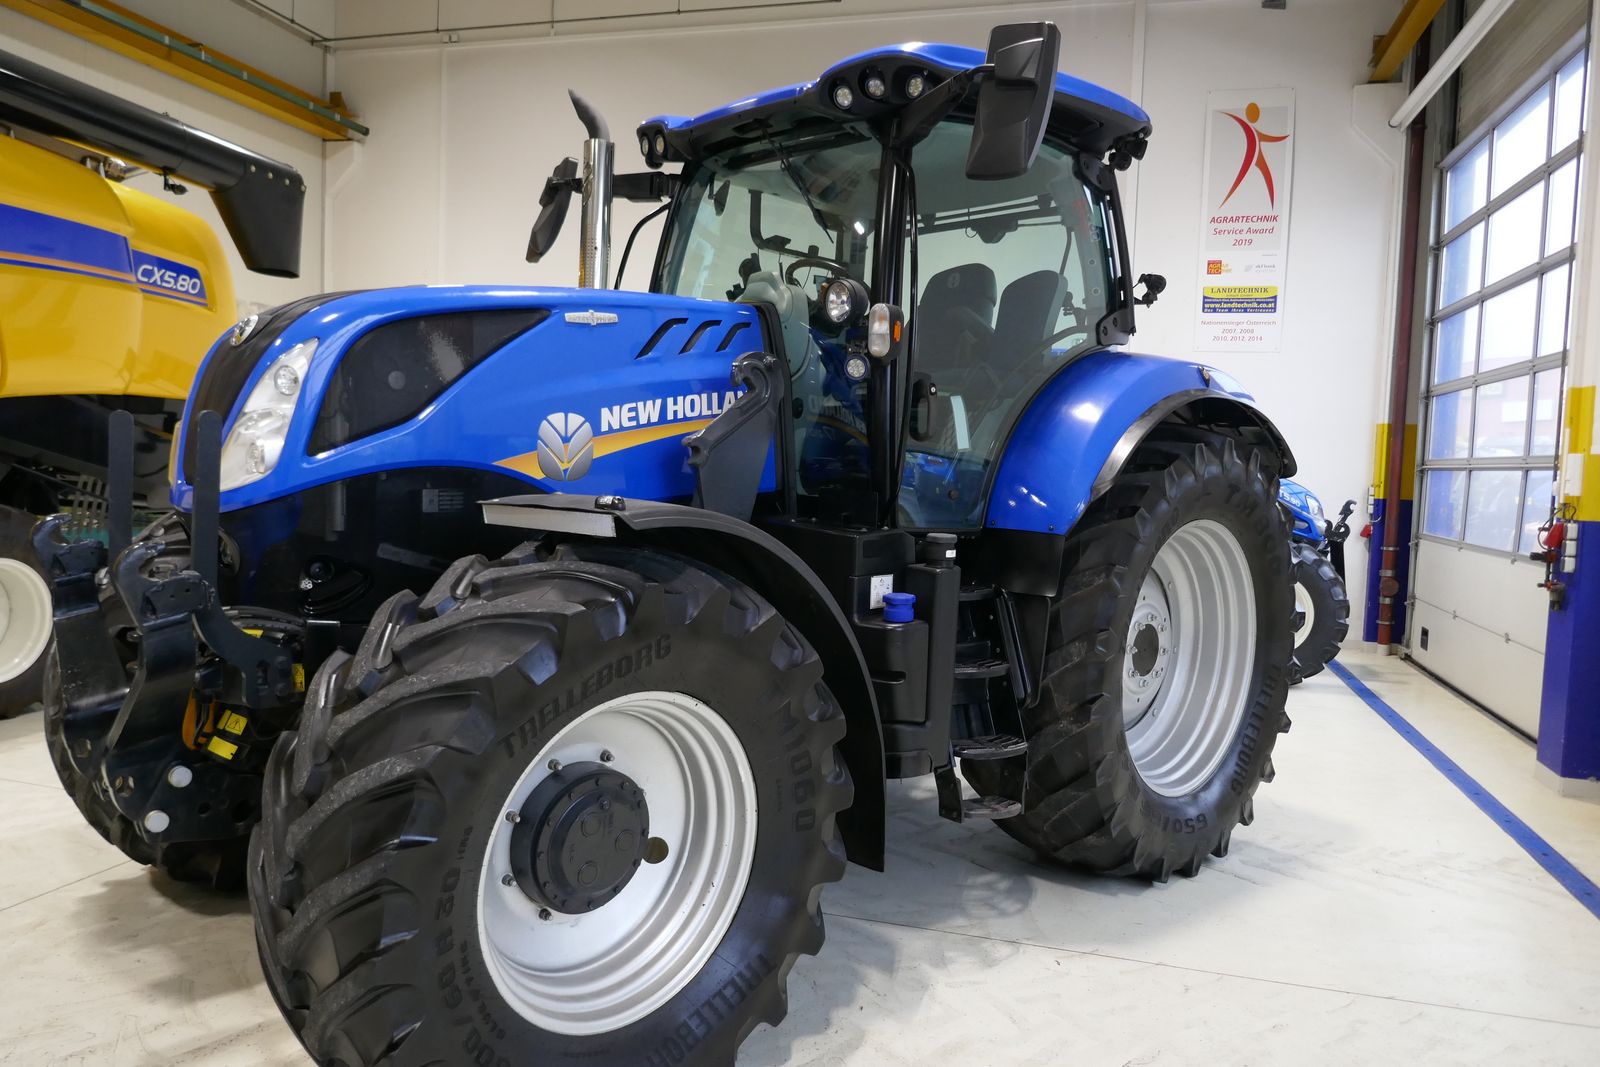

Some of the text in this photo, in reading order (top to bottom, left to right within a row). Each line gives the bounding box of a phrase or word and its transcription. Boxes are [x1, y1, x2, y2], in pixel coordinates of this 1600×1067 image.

[1209, 214, 1279, 224] AGRARTECHNIK
[1212, 226, 1275, 236] Service Award
[1232, 238, 1253, 247] 2019
[137, 264, 201, 294] CX5.80
[600, 391, 747, 432] NEW HOLLA
[497, 632, 672, 759] TRELLEBORG
[1230, 663, 1282, 797] TRELLEBORG
[645, 952, 778, 1067] TRELLEBOR
